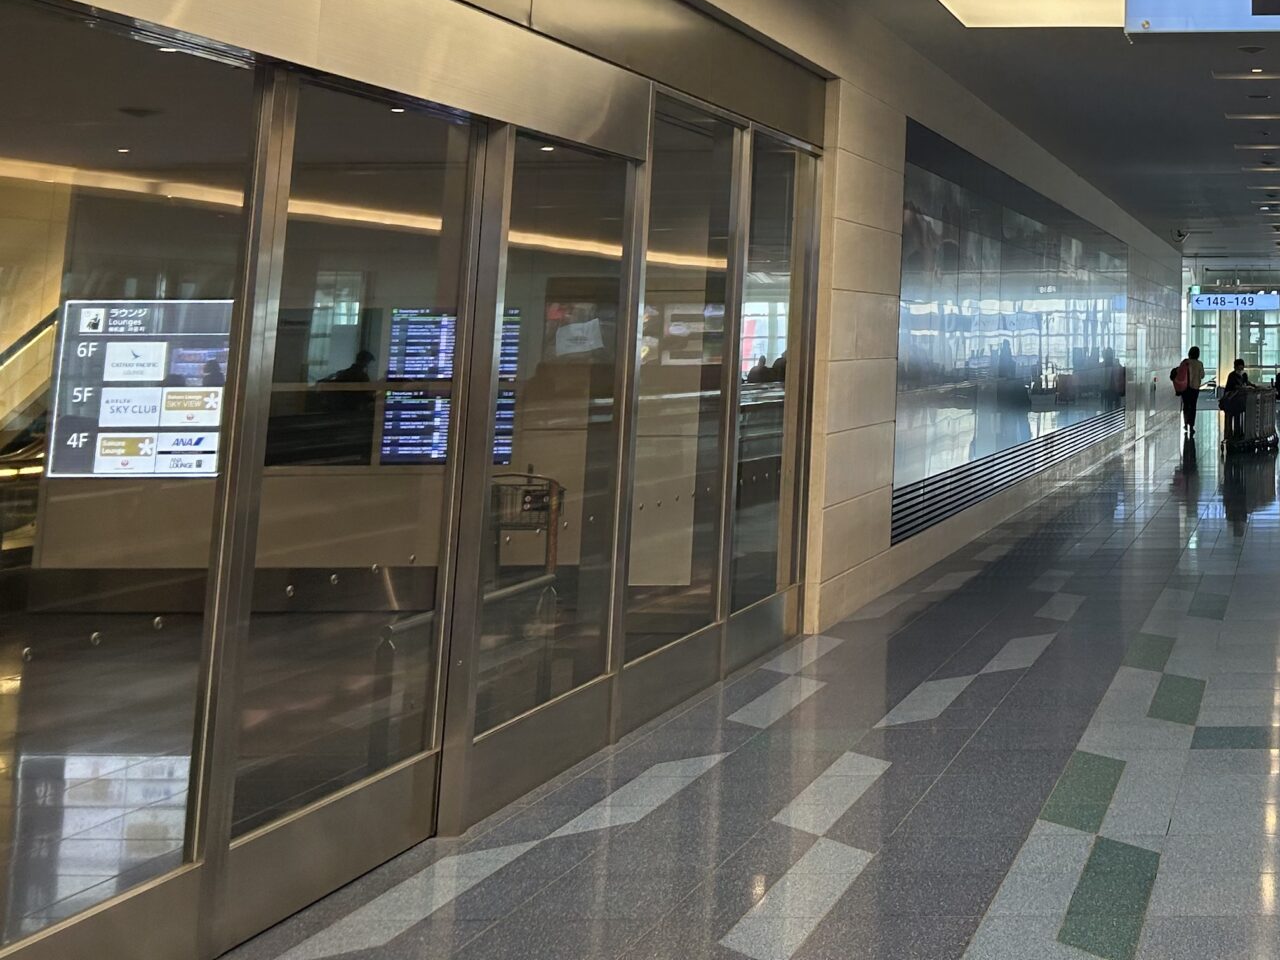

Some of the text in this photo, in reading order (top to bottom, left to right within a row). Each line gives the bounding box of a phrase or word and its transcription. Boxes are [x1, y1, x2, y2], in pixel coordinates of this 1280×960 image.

[1207, 296, 1254, 306] 148-149
[109, 308, 149, 318] ラウンジ
[108, 319, 142, 327] Lounges
[77, 342, 98, 357] 6F
[72, 387, 93, 403] 5F
[109, 405, 158, 414] SKY CLUB
[66, 433, 89, 448] 4F
[171, 438, 193, 446] ANA
